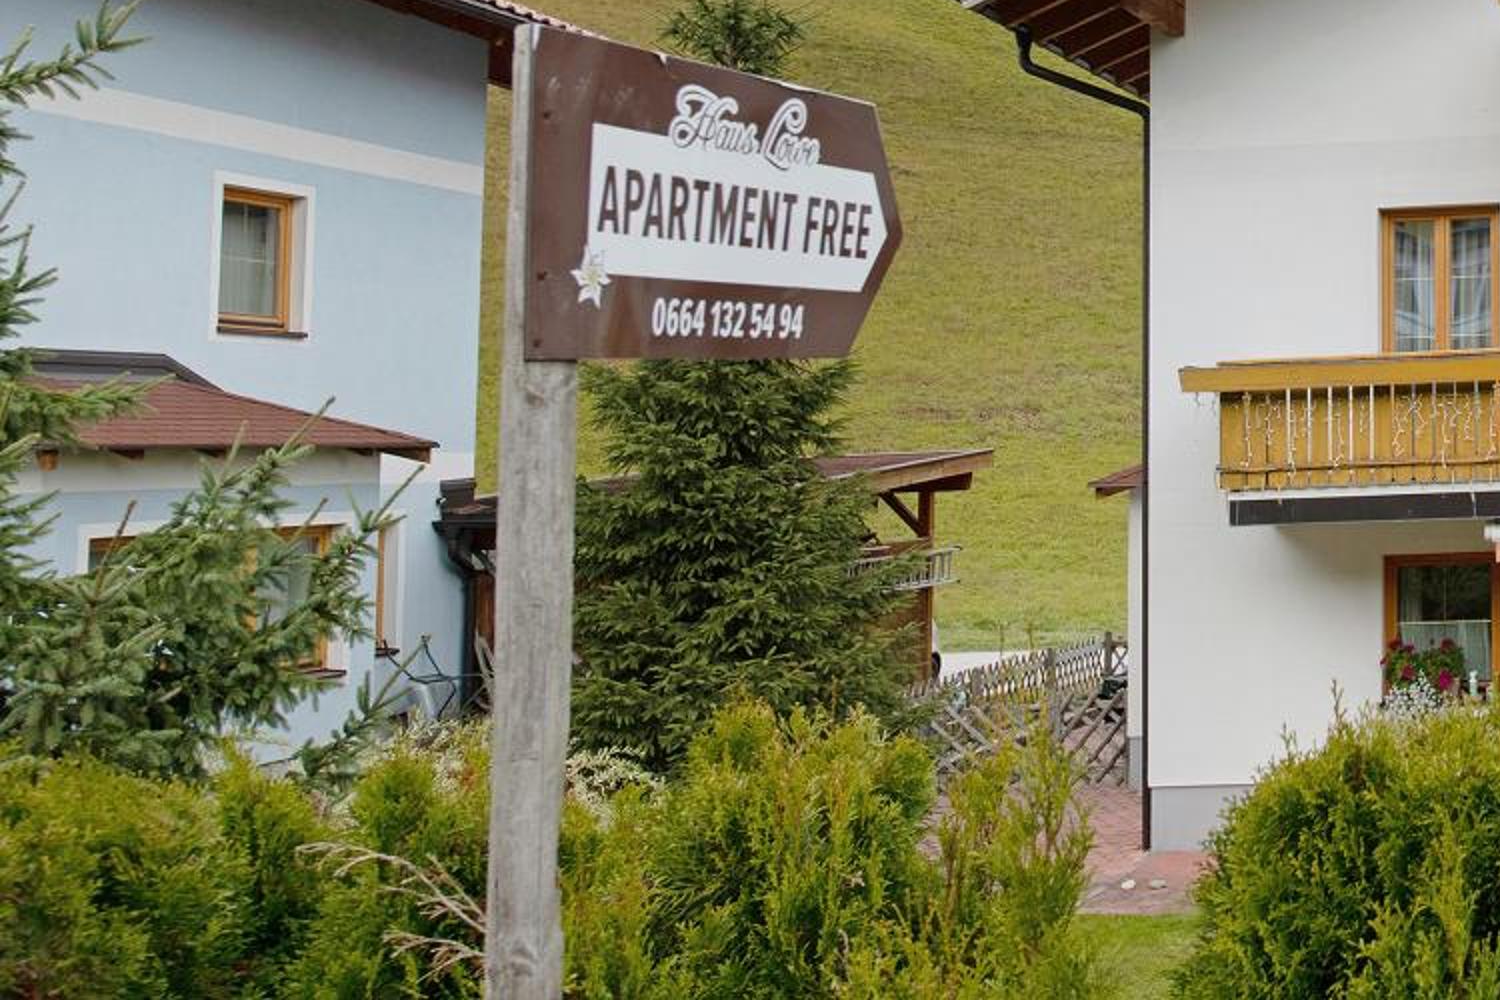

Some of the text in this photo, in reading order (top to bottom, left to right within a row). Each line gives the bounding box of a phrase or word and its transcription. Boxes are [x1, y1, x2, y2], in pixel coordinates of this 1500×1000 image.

[668, 84, 759, 153] Haus
[597, 165, 872, 260] APARTMENT FREE
[652, 297, 805, 340] 0664 132 54 94
